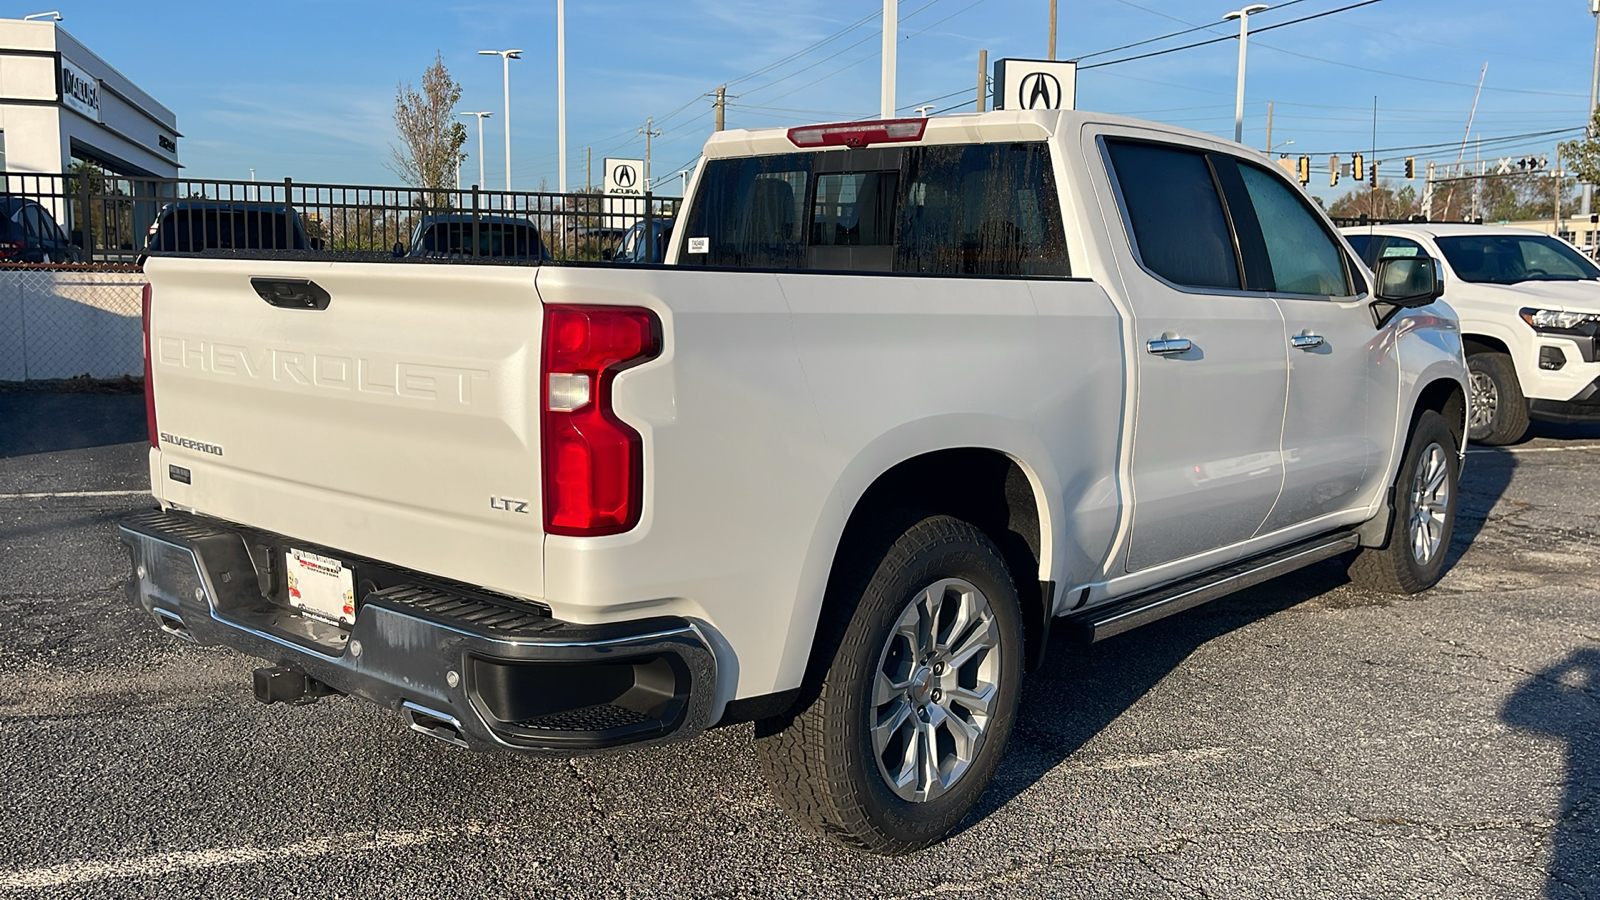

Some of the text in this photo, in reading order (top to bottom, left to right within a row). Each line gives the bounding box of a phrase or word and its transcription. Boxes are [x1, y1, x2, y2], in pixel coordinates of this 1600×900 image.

[158, 336, 491, 405] CHEVROLET
[160, 432, 223, 456] SILVERADO
[490, 496, 529, 514] LTZ
